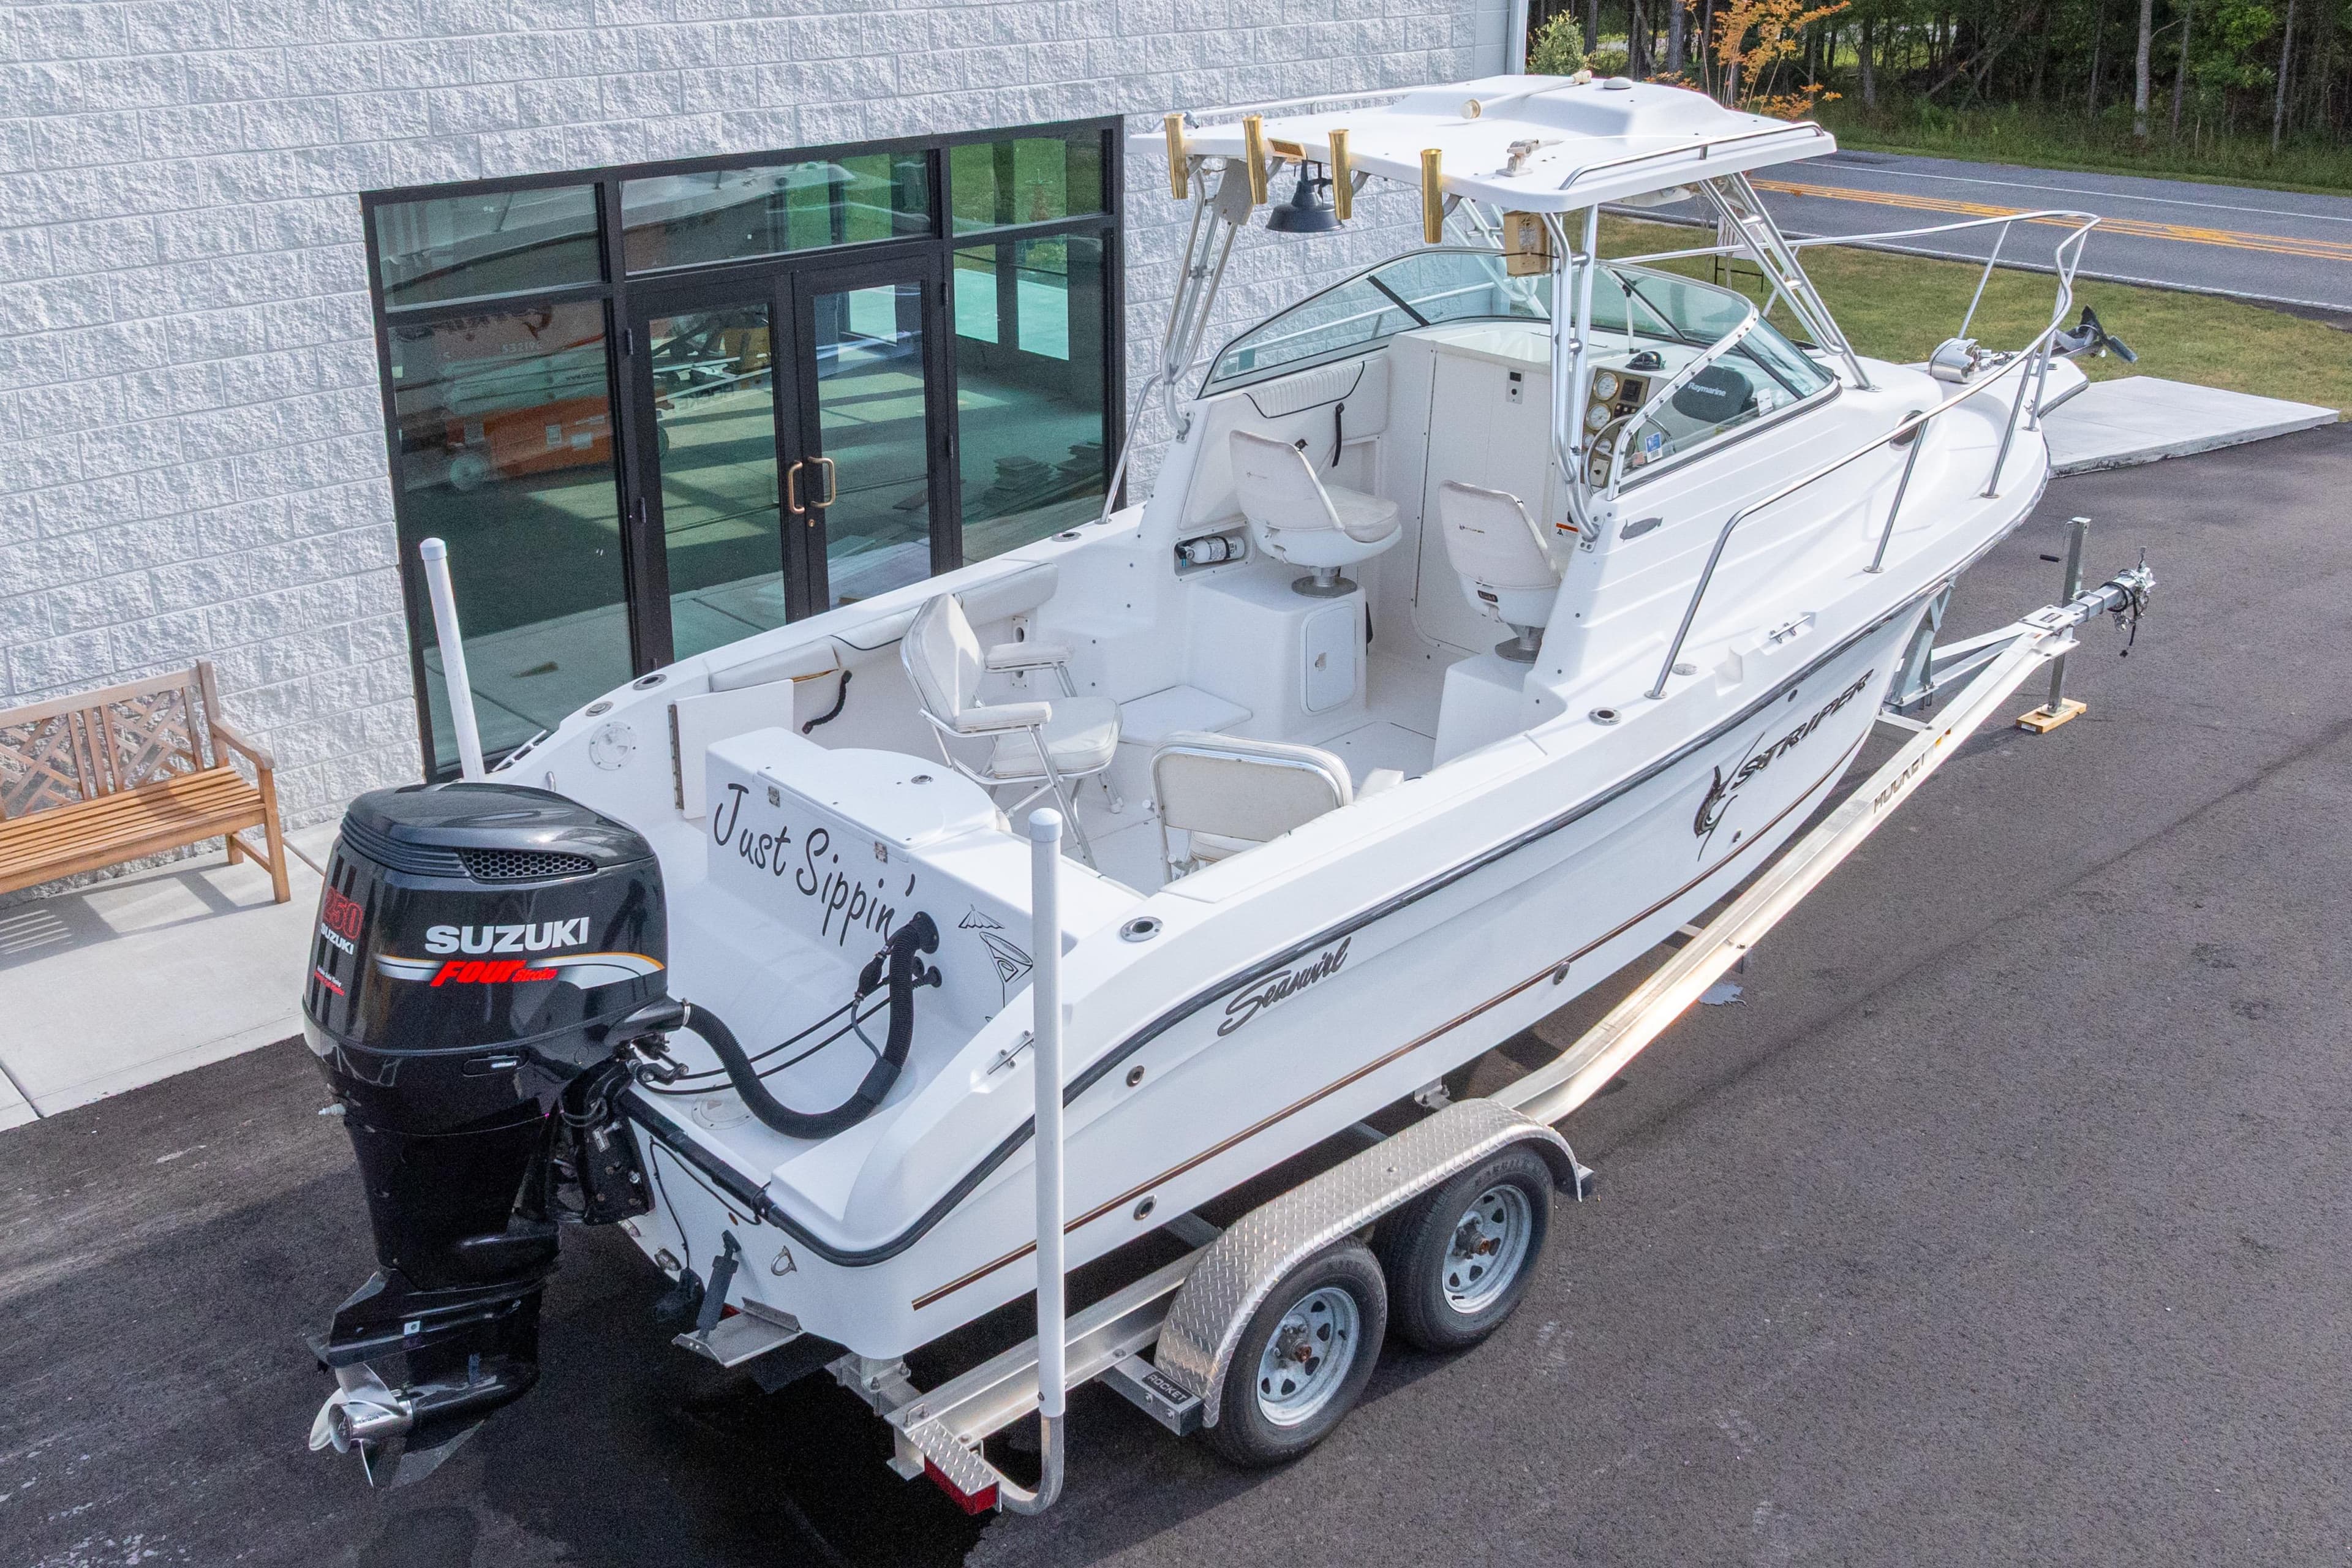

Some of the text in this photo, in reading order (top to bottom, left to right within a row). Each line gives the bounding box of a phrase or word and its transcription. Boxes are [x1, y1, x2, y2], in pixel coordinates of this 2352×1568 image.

[1688, 382, 1726, 396] Raymarine
[1730, 668, 1874, 791] STRIPER
[714, 783, 916, 947] Just Sippin'
[320, 922, 354, 956] SUZUKI
[424, 917, 589, 954] SUZUKI
[1218, 936, 1351, 1036] Seaswirl
[1147, 1374, 1187, 1401] ROCKET
